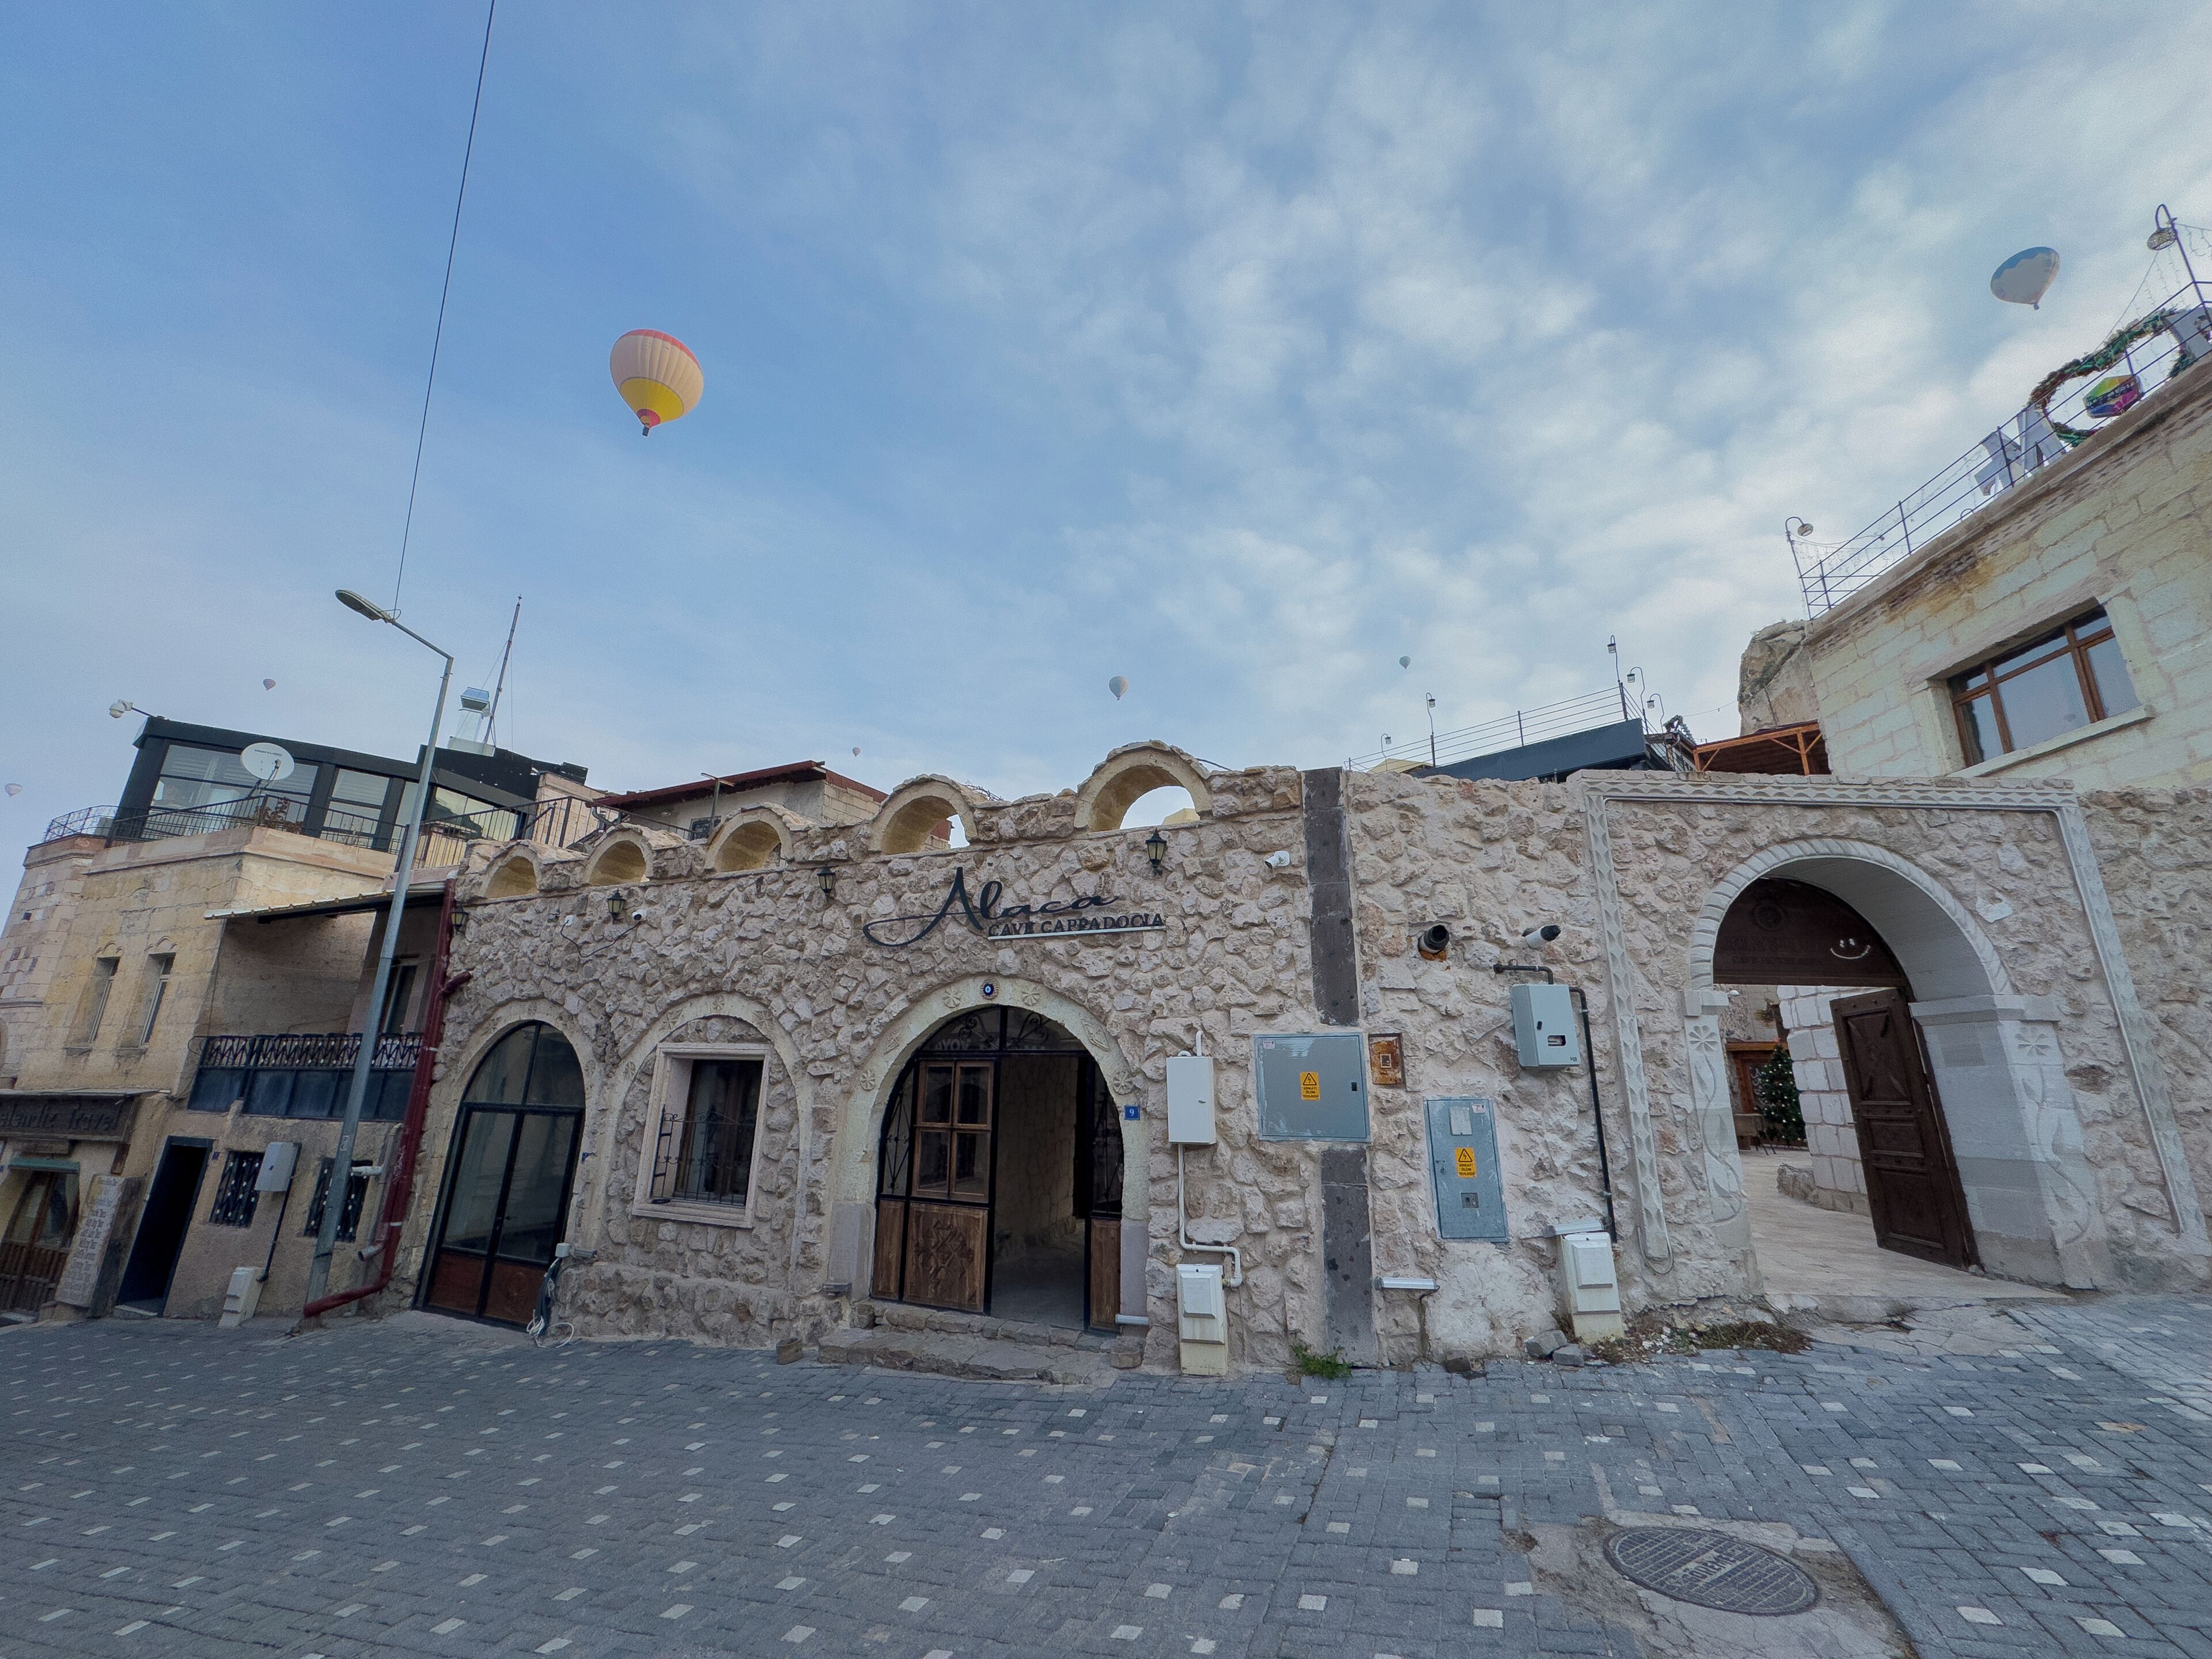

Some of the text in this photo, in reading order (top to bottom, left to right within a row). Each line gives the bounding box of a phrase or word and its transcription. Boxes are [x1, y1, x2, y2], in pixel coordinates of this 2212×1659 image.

[863, 867, 1120, 947] Alaca
[988, 913, 1165, 936] CAVE CAPPADOCIA
[1129, 1108, 1134, 1116] 9
